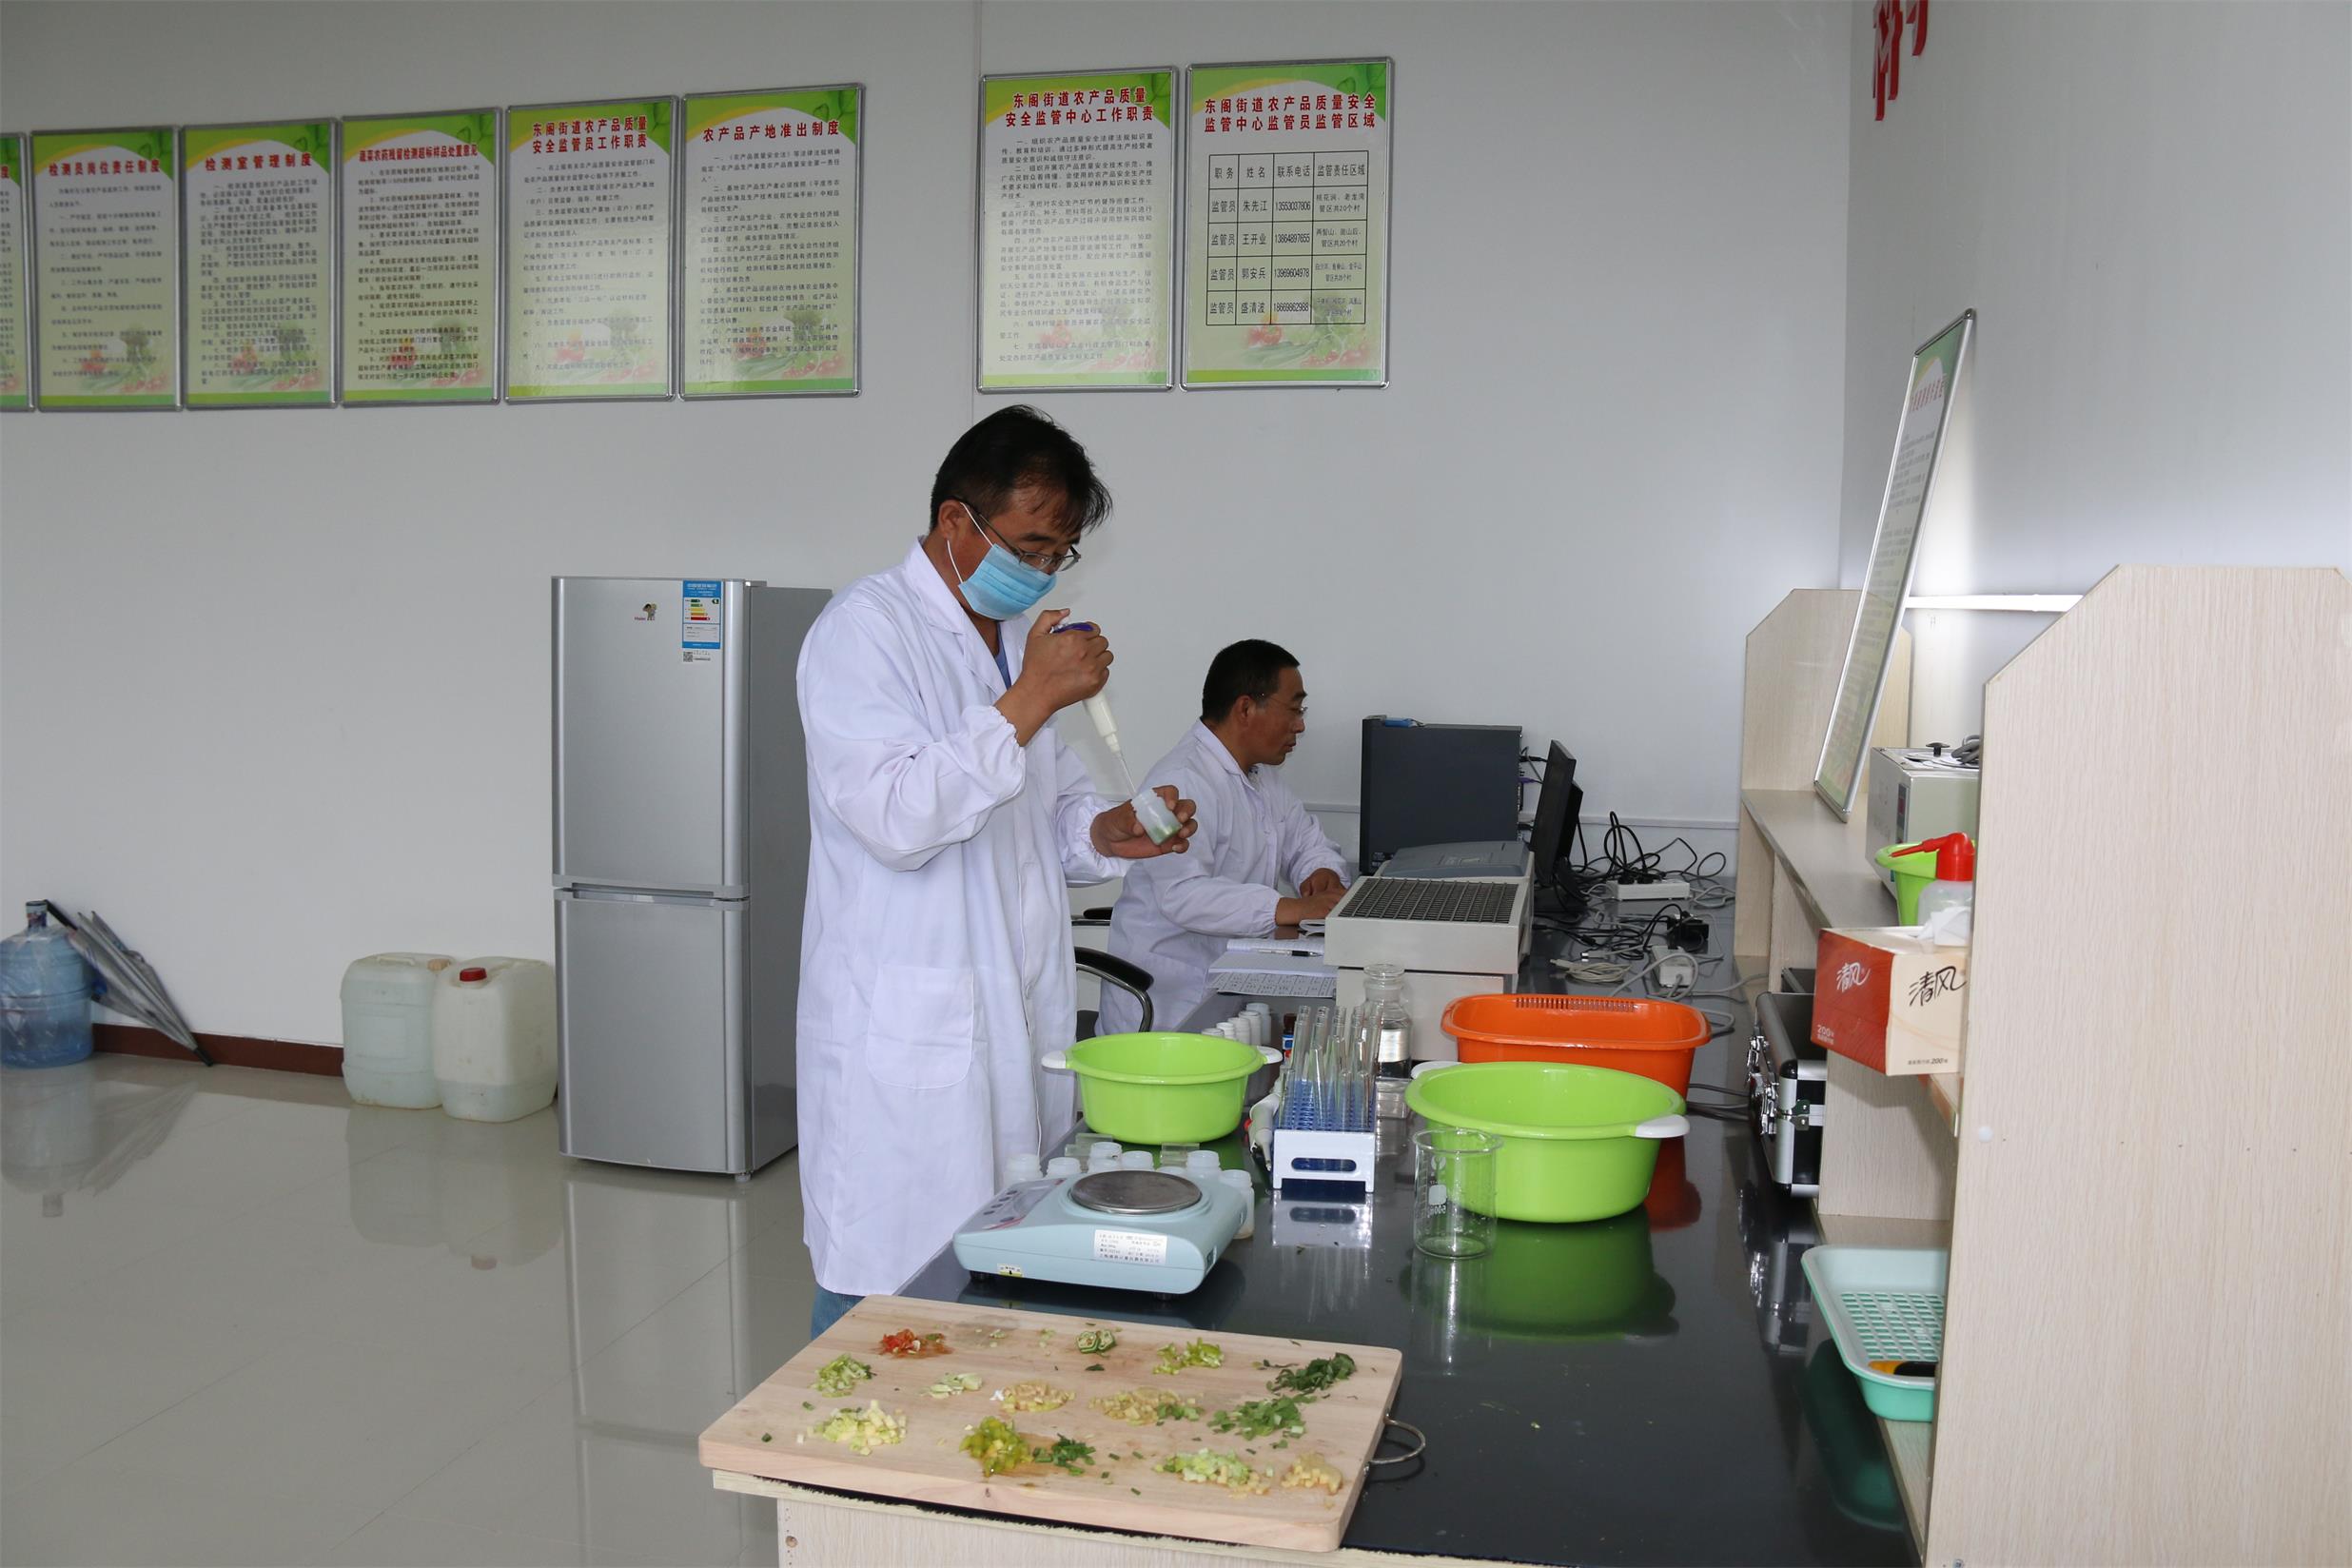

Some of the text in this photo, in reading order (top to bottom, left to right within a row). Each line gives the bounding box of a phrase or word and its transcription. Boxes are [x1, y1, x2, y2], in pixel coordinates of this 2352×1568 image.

[1013, 88, 1147, 108] 东阁街道农产品质量
[1205, 93, 1376, 114] 东阁街道农产品质量安全
[1006, 106, 1153, 127] 安全监管中心工作职责
[1205, 112, 1376, 133] 监管中心监管员监管区域
[533, 116, 648, 137] 东阁街道农产品质量
[703, 120, 839, 143] 农产品产地准出制度
[533, 133, 648, 154] 安全监管员工作职责
[206, 152, 312, 171] 检测室管理制度
[1214, 167, 1234, 179] 职务
[1246, 167, 1265, 178] 姓名
[1277, 165, 1310, 177] 联系电话
[1317, 164, 1365, 177] 监管责任区域
[1211, 201, 1236, 212] 监管员
[1243, 200, 1268, 212] 朱先江
[1210, 233, 1235, 245] 监管员
[1242, 233, 1266, 245] 王开业
[1210, 268, 1234, 281] 监管员
[1209, 302, 1234, 314] 监管员
[1836, 961, 1871, 993] 清风
[1908, 966, 1968, 1007] 清风
